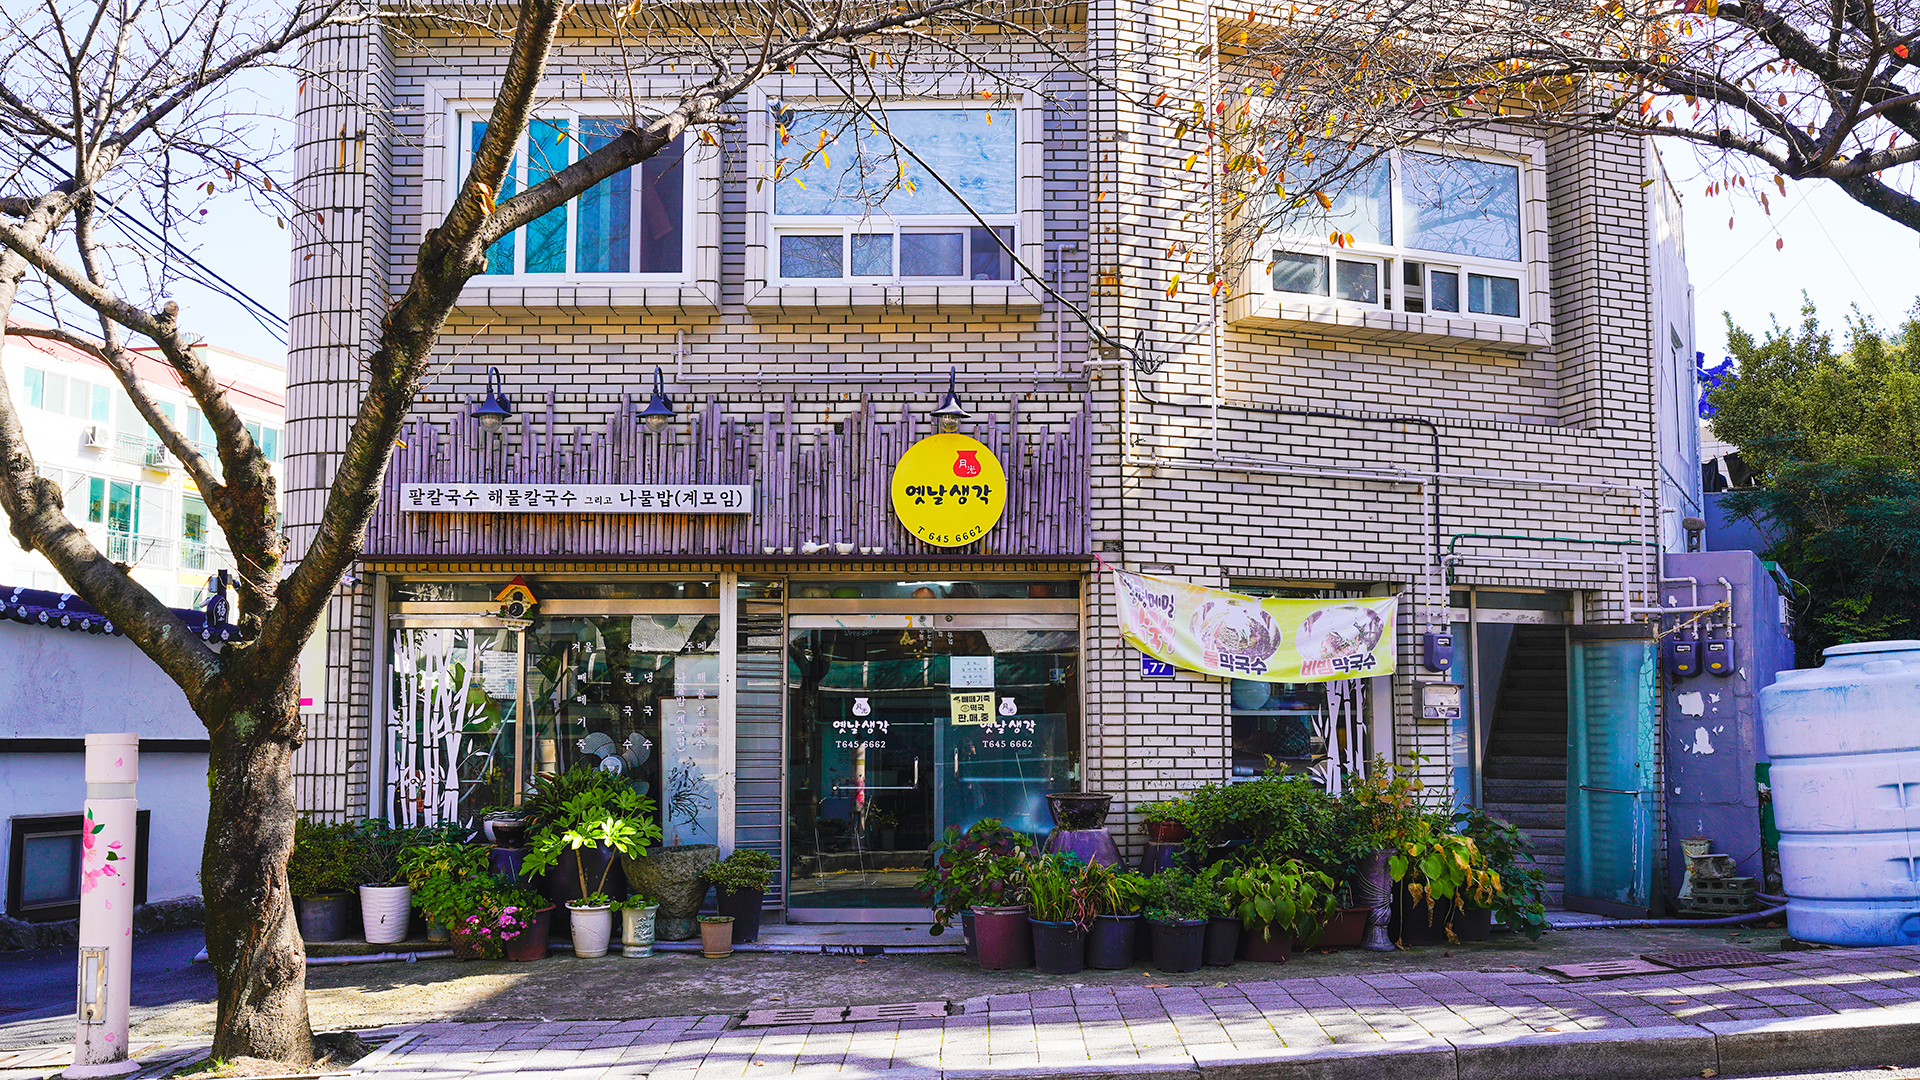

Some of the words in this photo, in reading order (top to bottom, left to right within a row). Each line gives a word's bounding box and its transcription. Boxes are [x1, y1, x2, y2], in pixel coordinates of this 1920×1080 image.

[408, 488, 480, 507] 팥칼국수
[487, 489, 577, 507] 해물칼국수
[584, 496, 613, 506] 그리고
[619, 489, 743, 508] 나물밥(계모임)
[905, 484, 992, 505] 옛날생각
[917, 526, 925, 534] T
[928, 532, 949, 543] 645
[955, 525, 983, 542] 6662
[1149, 662, 1167, 673] 77
[1203, 649, 1267, 675] 물막국수
[1301, 652, 1376, 677] 비빔막국수
[833, 720, 890, 734] 옛날생각
[1010, 740, 1033, 748] 6662
